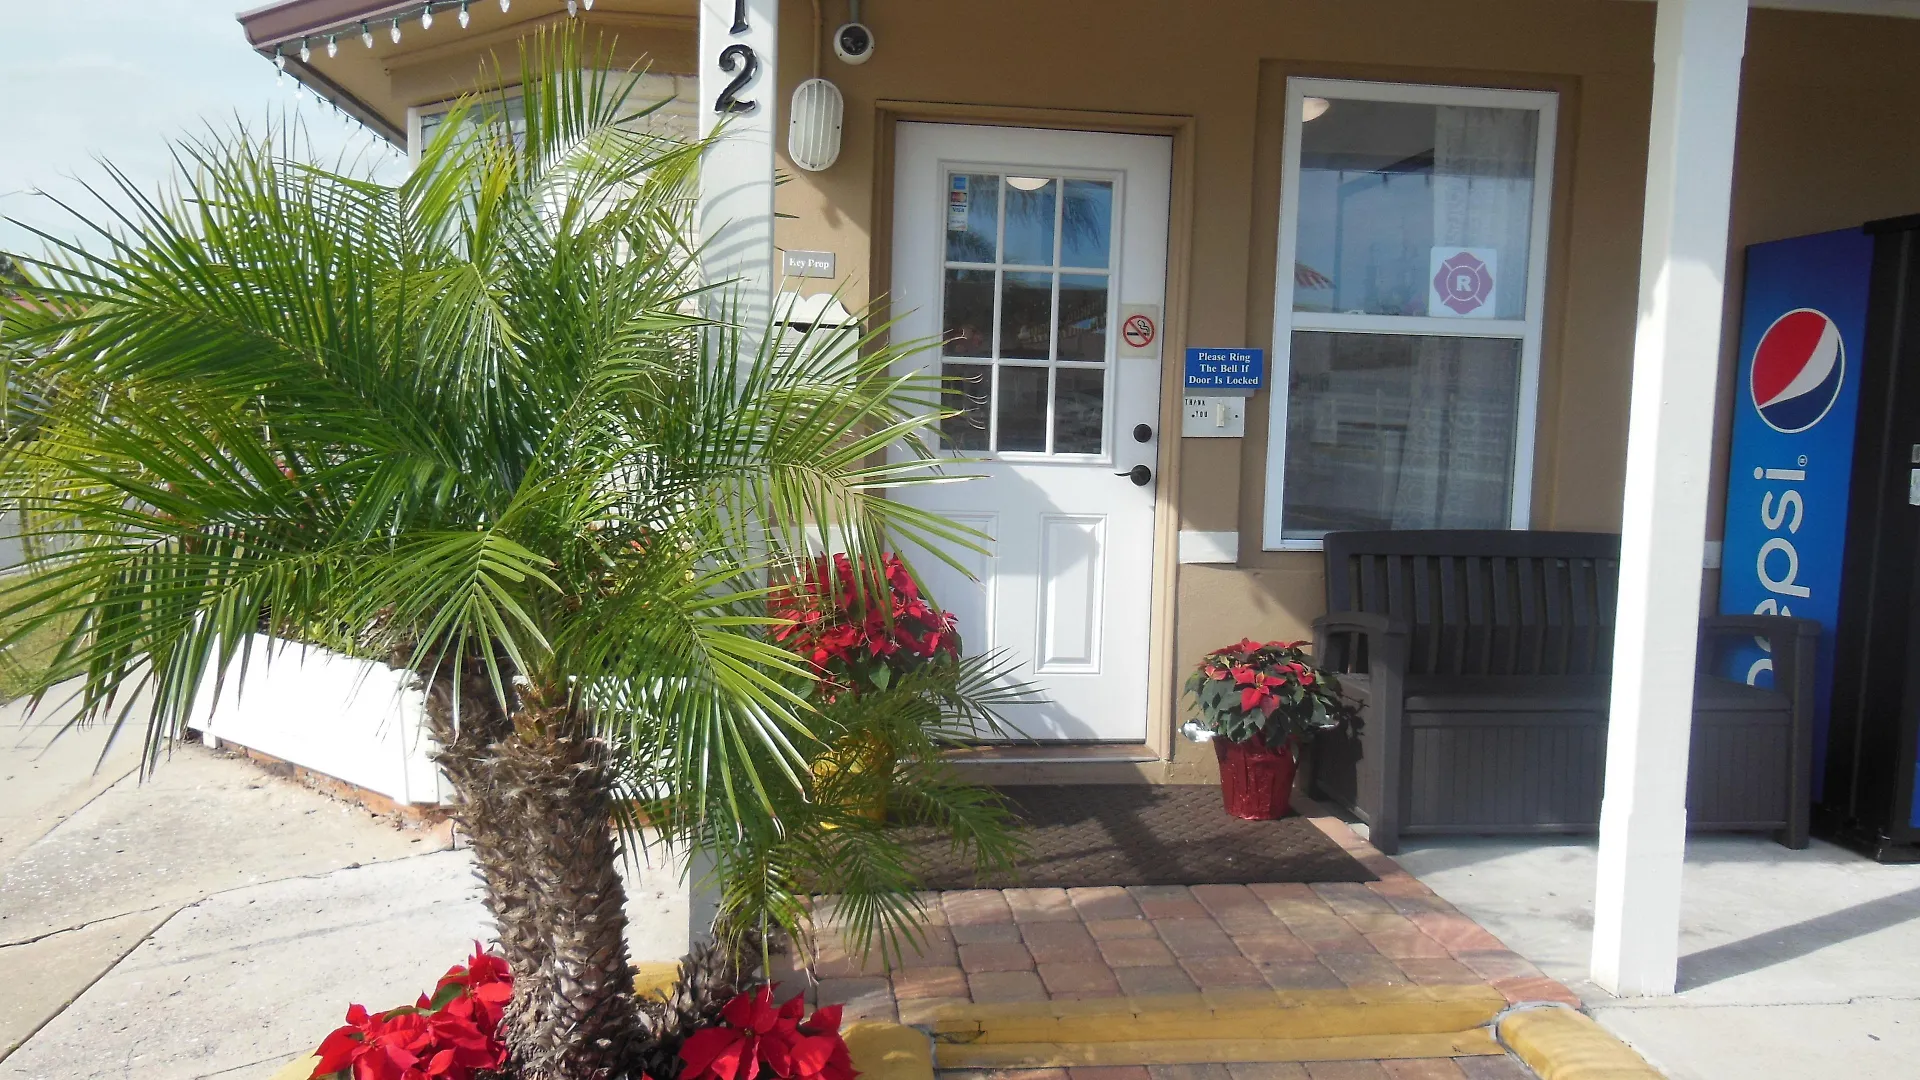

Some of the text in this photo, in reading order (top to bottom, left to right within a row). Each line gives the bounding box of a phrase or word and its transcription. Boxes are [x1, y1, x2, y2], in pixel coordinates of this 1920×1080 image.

[789, 257, 806, 269] Key
[1456, 275, 1472, 291] R
[1198, 352, 1251, 363] Please Ring
[1200, 364, 1250, 373] The Bell If
[1188, 375, 1259, 385] Door Is Locked
[1746, 466, 1811, 686] psi
